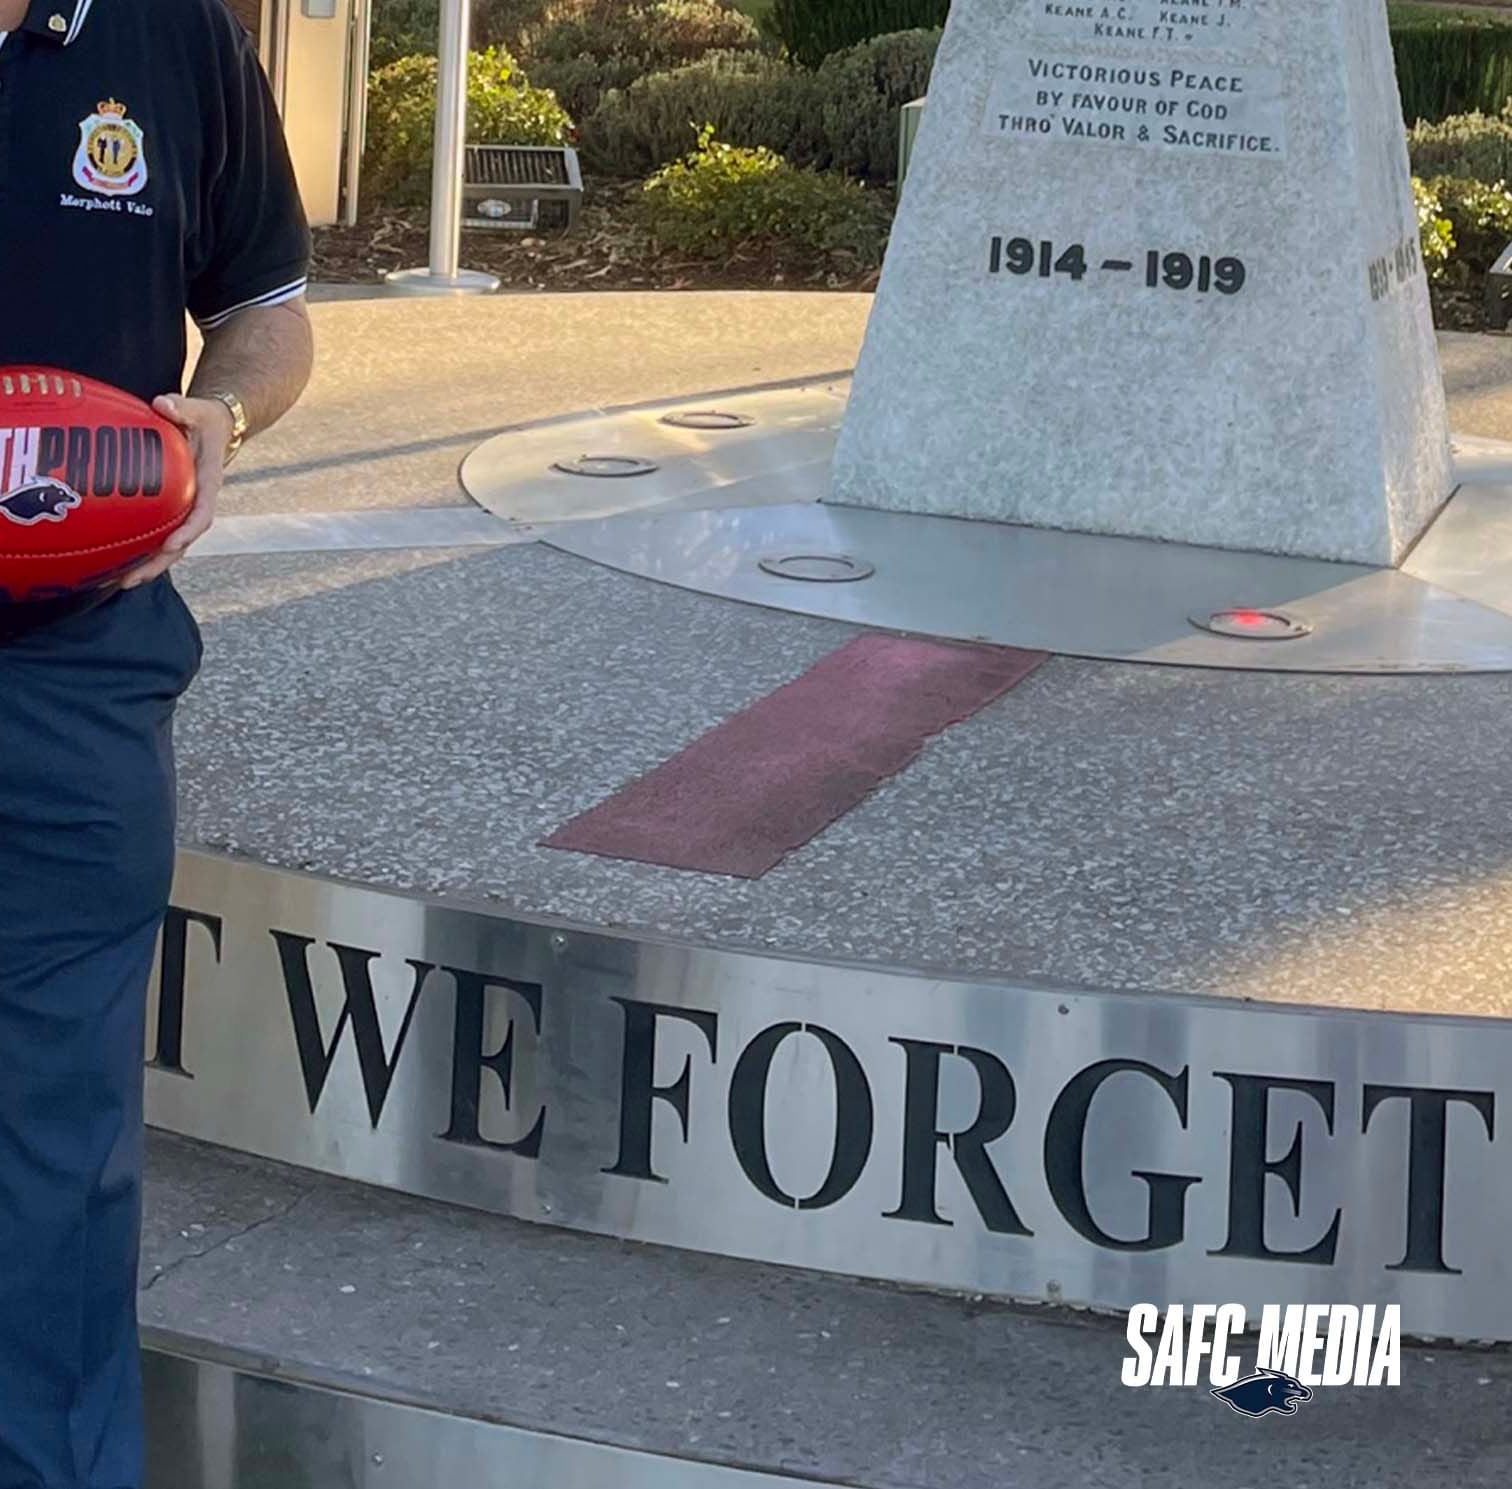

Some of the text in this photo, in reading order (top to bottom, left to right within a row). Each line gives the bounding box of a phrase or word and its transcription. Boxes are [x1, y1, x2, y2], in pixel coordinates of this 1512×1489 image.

[1045, 3, 1094, 18] KEANE
[1160, 11, 1208, 26] KEANE
[1094, 23, 1144, 39] KEANE
[1028, 58, 1243, 92] VICTORIOUS PEACE
[1036, 91, 1064, 106] BY
[1072, 92, 1148, 114] FAVOUR
[1156, 100, 1179, 116] OF
[1062, 117, 1125, 140] VALOR
[1137, 125, 1150, 142] &
[1163, 126, 1280, 152] SACRIFICE.
[60, 194, 153, 217] Morphett Vale
[268, 928, 549, 1159] WE
[601, 995, 1496, 1276] FORGET
